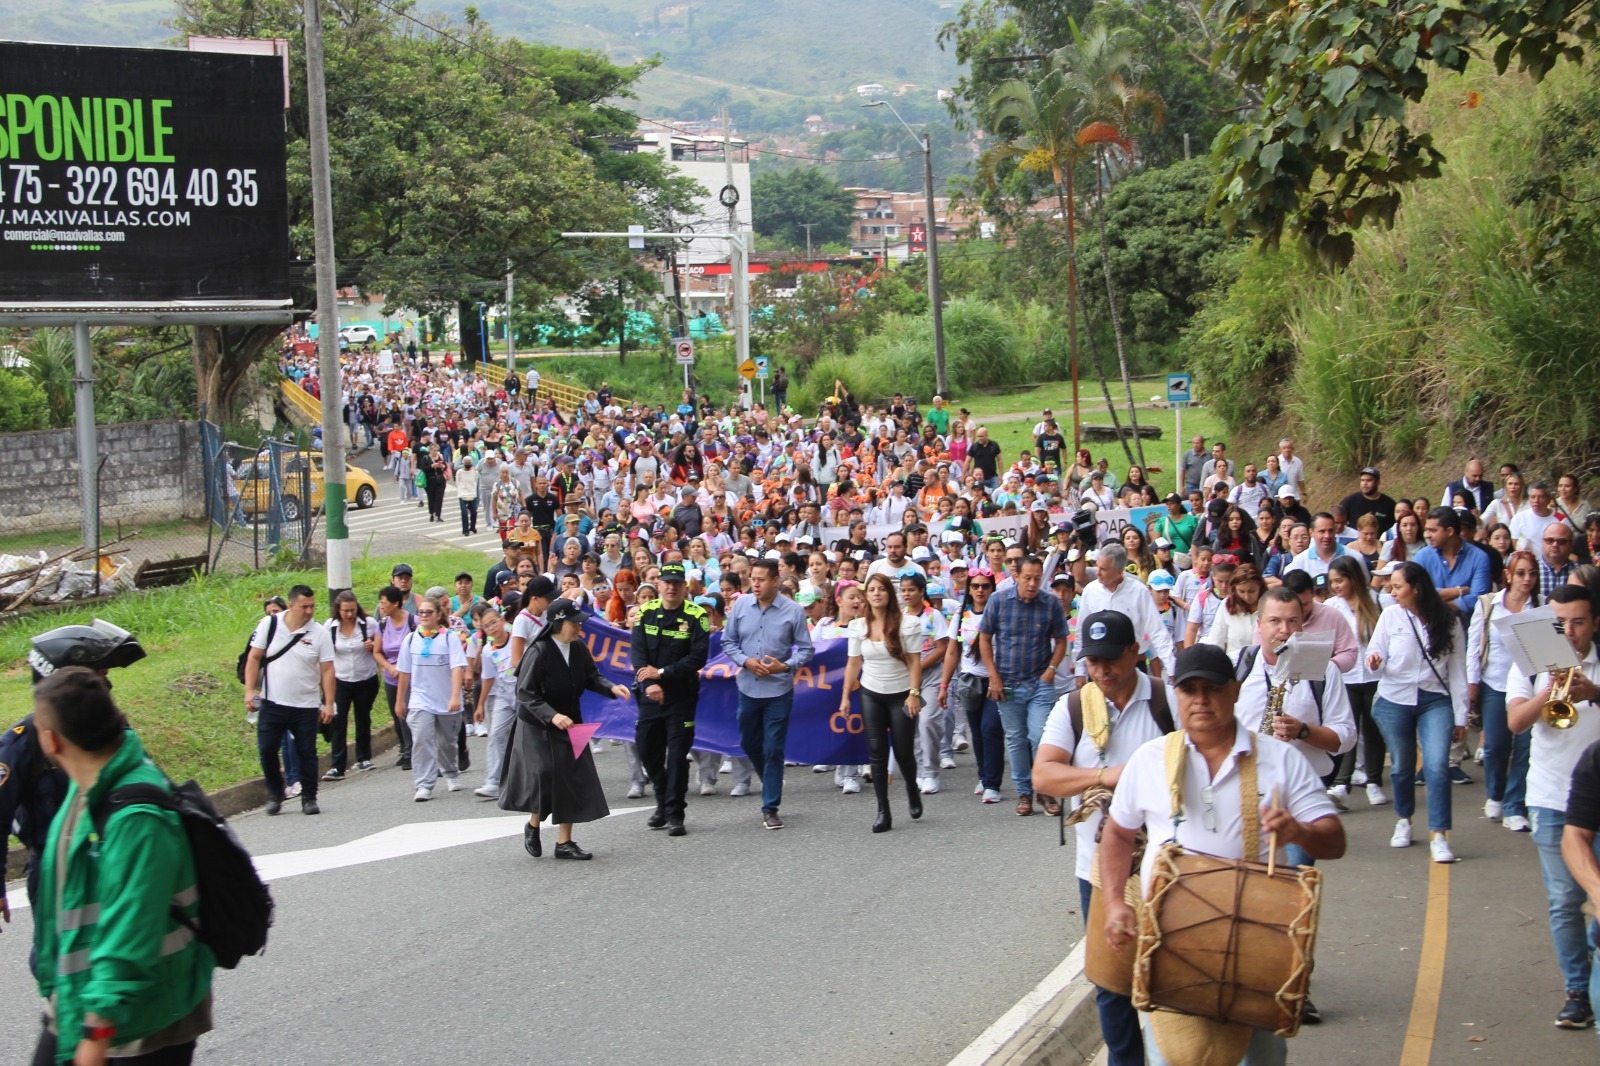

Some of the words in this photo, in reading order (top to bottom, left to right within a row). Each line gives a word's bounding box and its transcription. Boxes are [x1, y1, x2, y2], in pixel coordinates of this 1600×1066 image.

[9, 164, 43, 204] 75
[66, 165, 119, 206] 322
[126, 167, 178, 206] 694
[186, 168, 218, 207] 40
[226, 168, 258, 207] 35
[0, 208, 191, 227] .MAXIVALLAS.COM
[4, 229, 125, 243] comercial@maxivallas.com
[1099, 518, 1127, 534] DAD
[829, 711, 865, 734] CO
